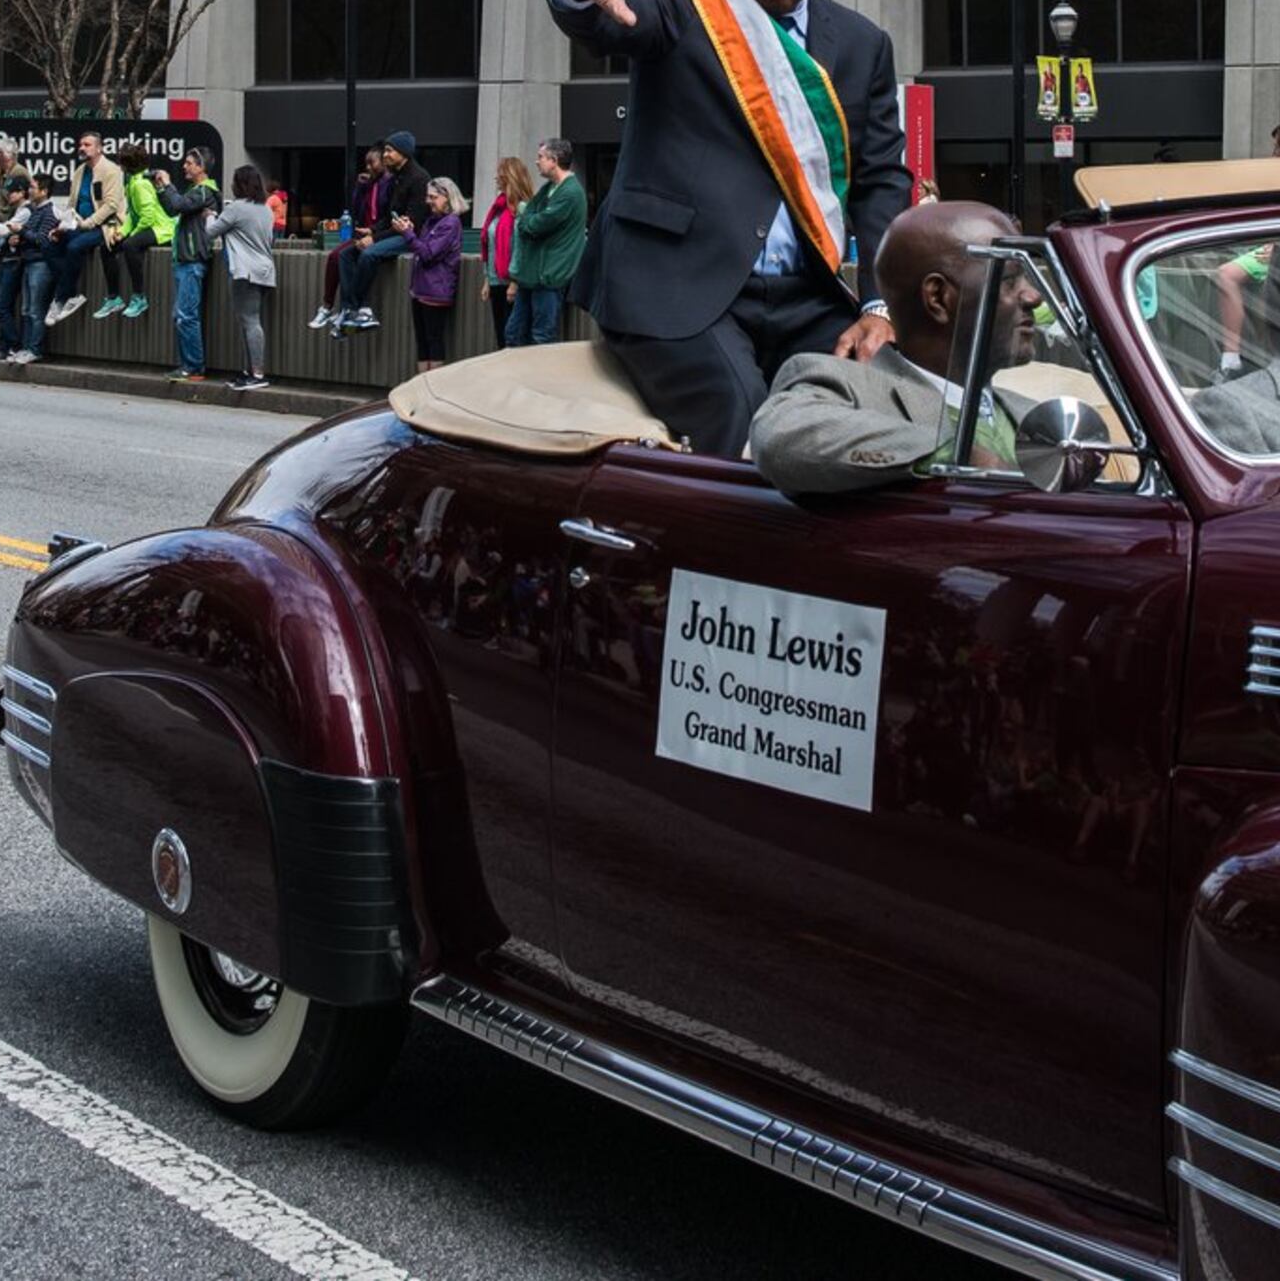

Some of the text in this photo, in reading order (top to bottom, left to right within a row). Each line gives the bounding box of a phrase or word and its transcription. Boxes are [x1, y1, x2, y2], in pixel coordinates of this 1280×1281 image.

[103, 131, 185, 161] arking
[680, 599, 863, 678] John Lewis
[670, 658, 867, 732] U.S. Congressman
[684, 711, 842, 776] Grand Marshal
